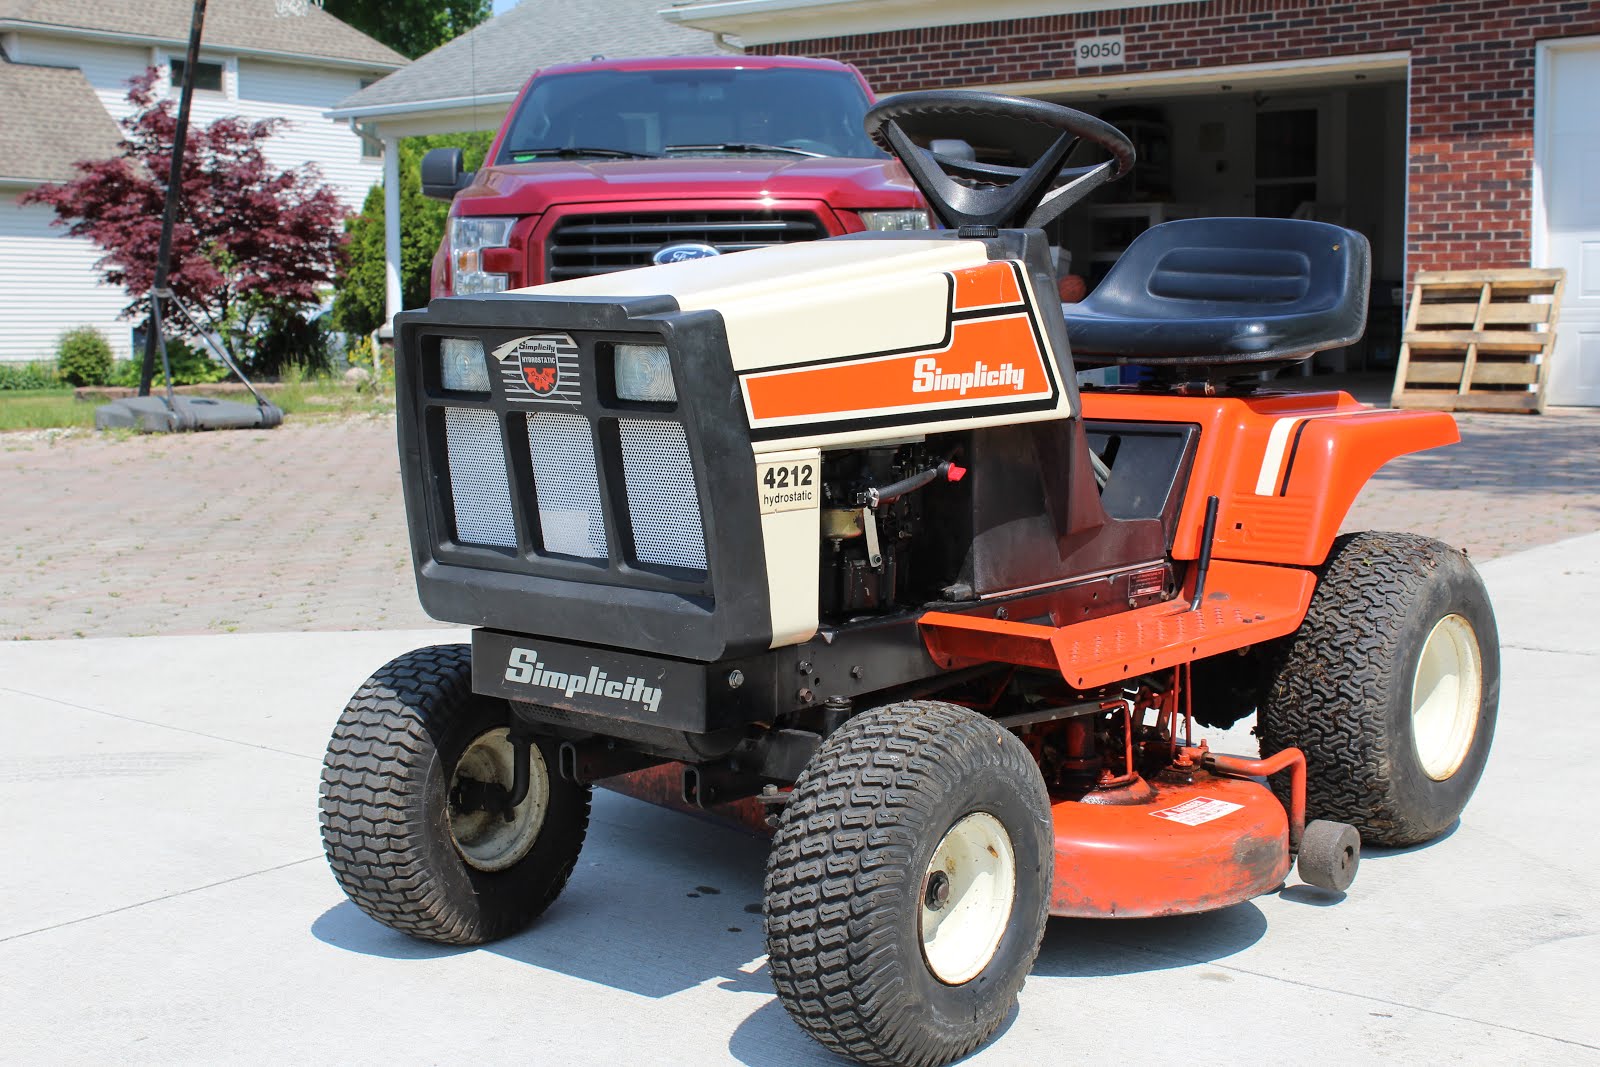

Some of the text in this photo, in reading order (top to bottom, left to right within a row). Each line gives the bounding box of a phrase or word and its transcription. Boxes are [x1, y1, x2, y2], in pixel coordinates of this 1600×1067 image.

[1080, 42, 1121, 59] 9050
[518, 340, 556, 353] Simplicity
[521, 356, 556, 364] HYDROSTATIC
[912, 357, 1025, 395] Simplicity
[763, 464, 813, 489] 4212
[763, 489, 812, 507] hydrostatic
[504, 647, 663, 713] Simplicity
